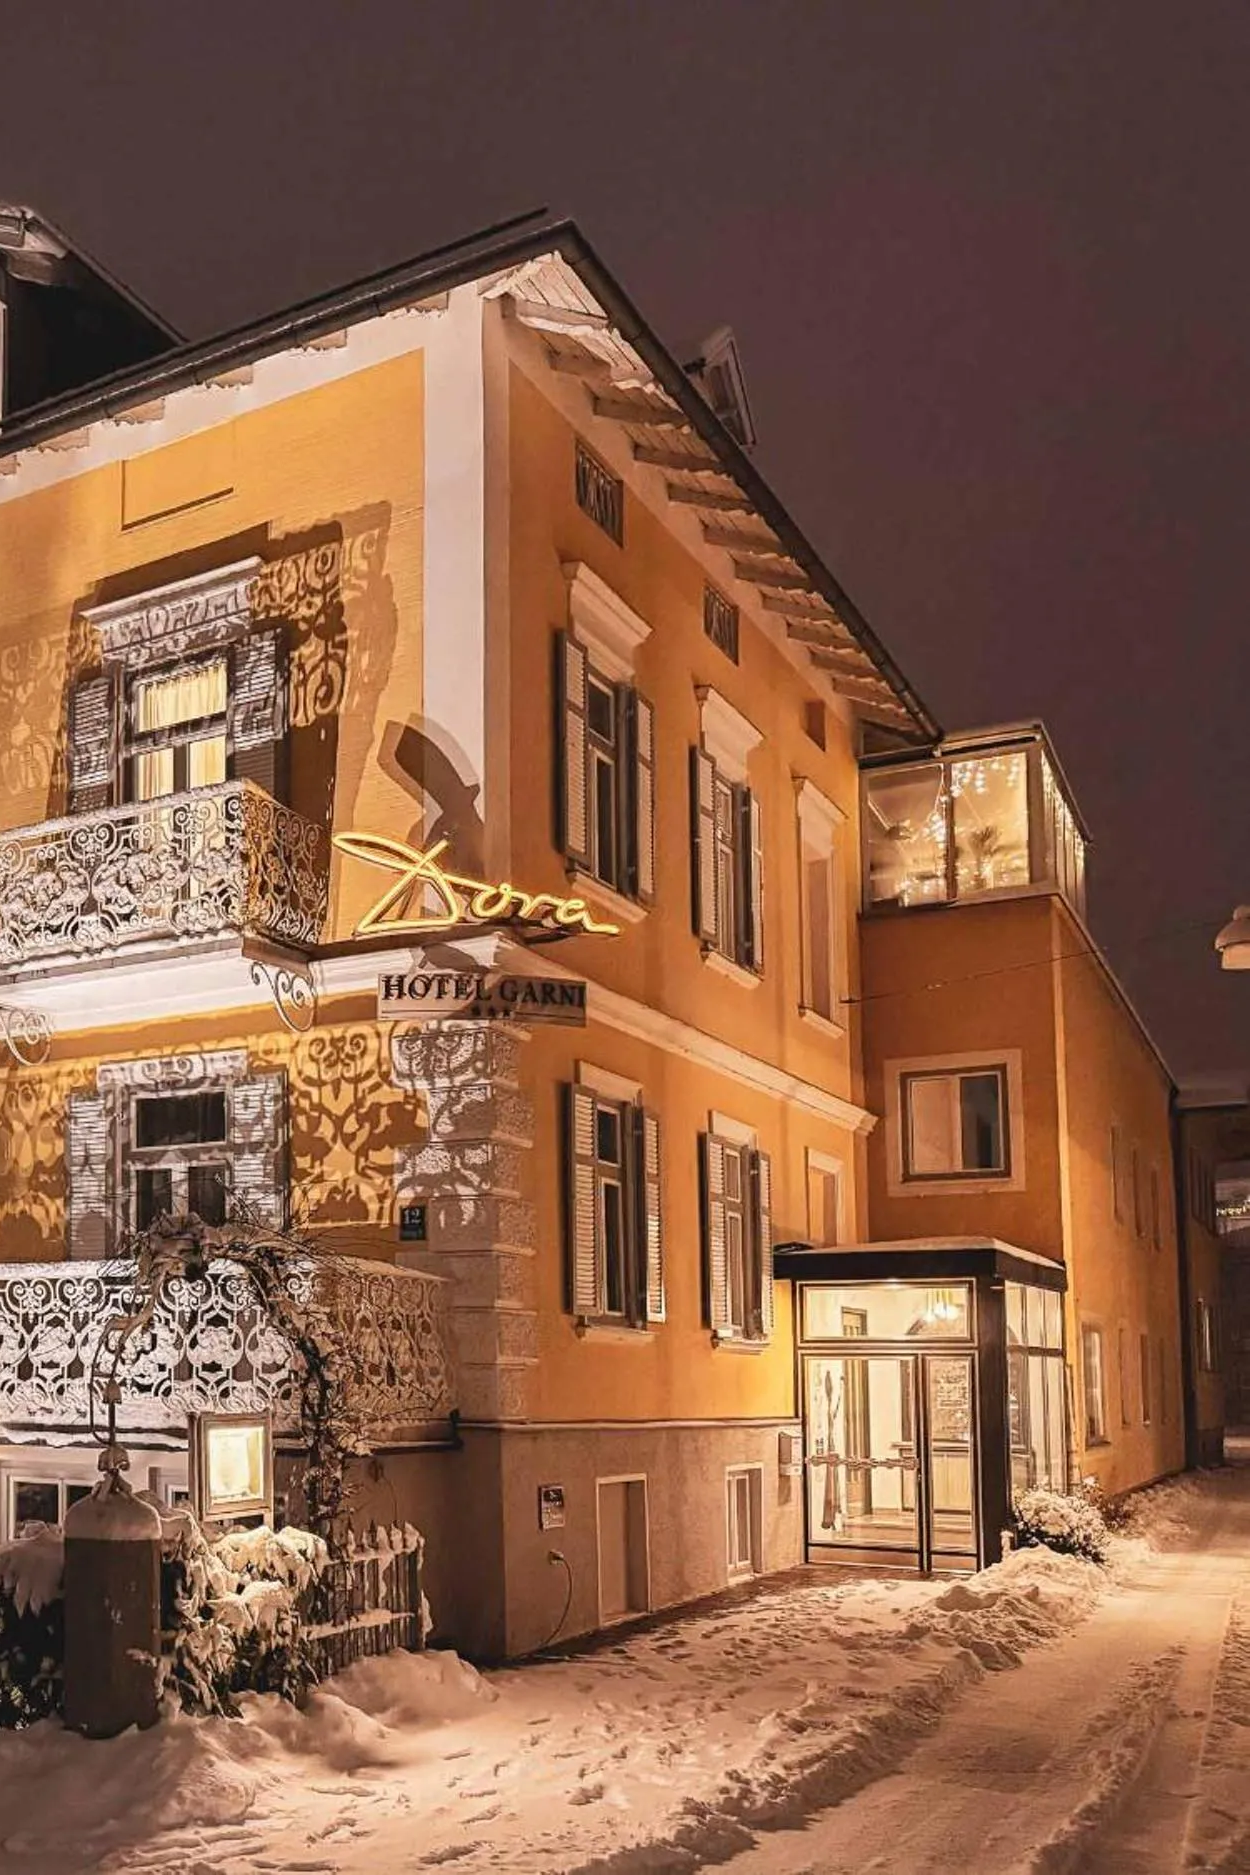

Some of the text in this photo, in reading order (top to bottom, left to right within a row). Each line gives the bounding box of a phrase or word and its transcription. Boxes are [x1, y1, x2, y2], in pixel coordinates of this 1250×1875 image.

[332, 832, 620, 935] Dora
[382, 974, 586, 1008] HOTEL GARNI
[403, 1208, 421, 1224] 12
